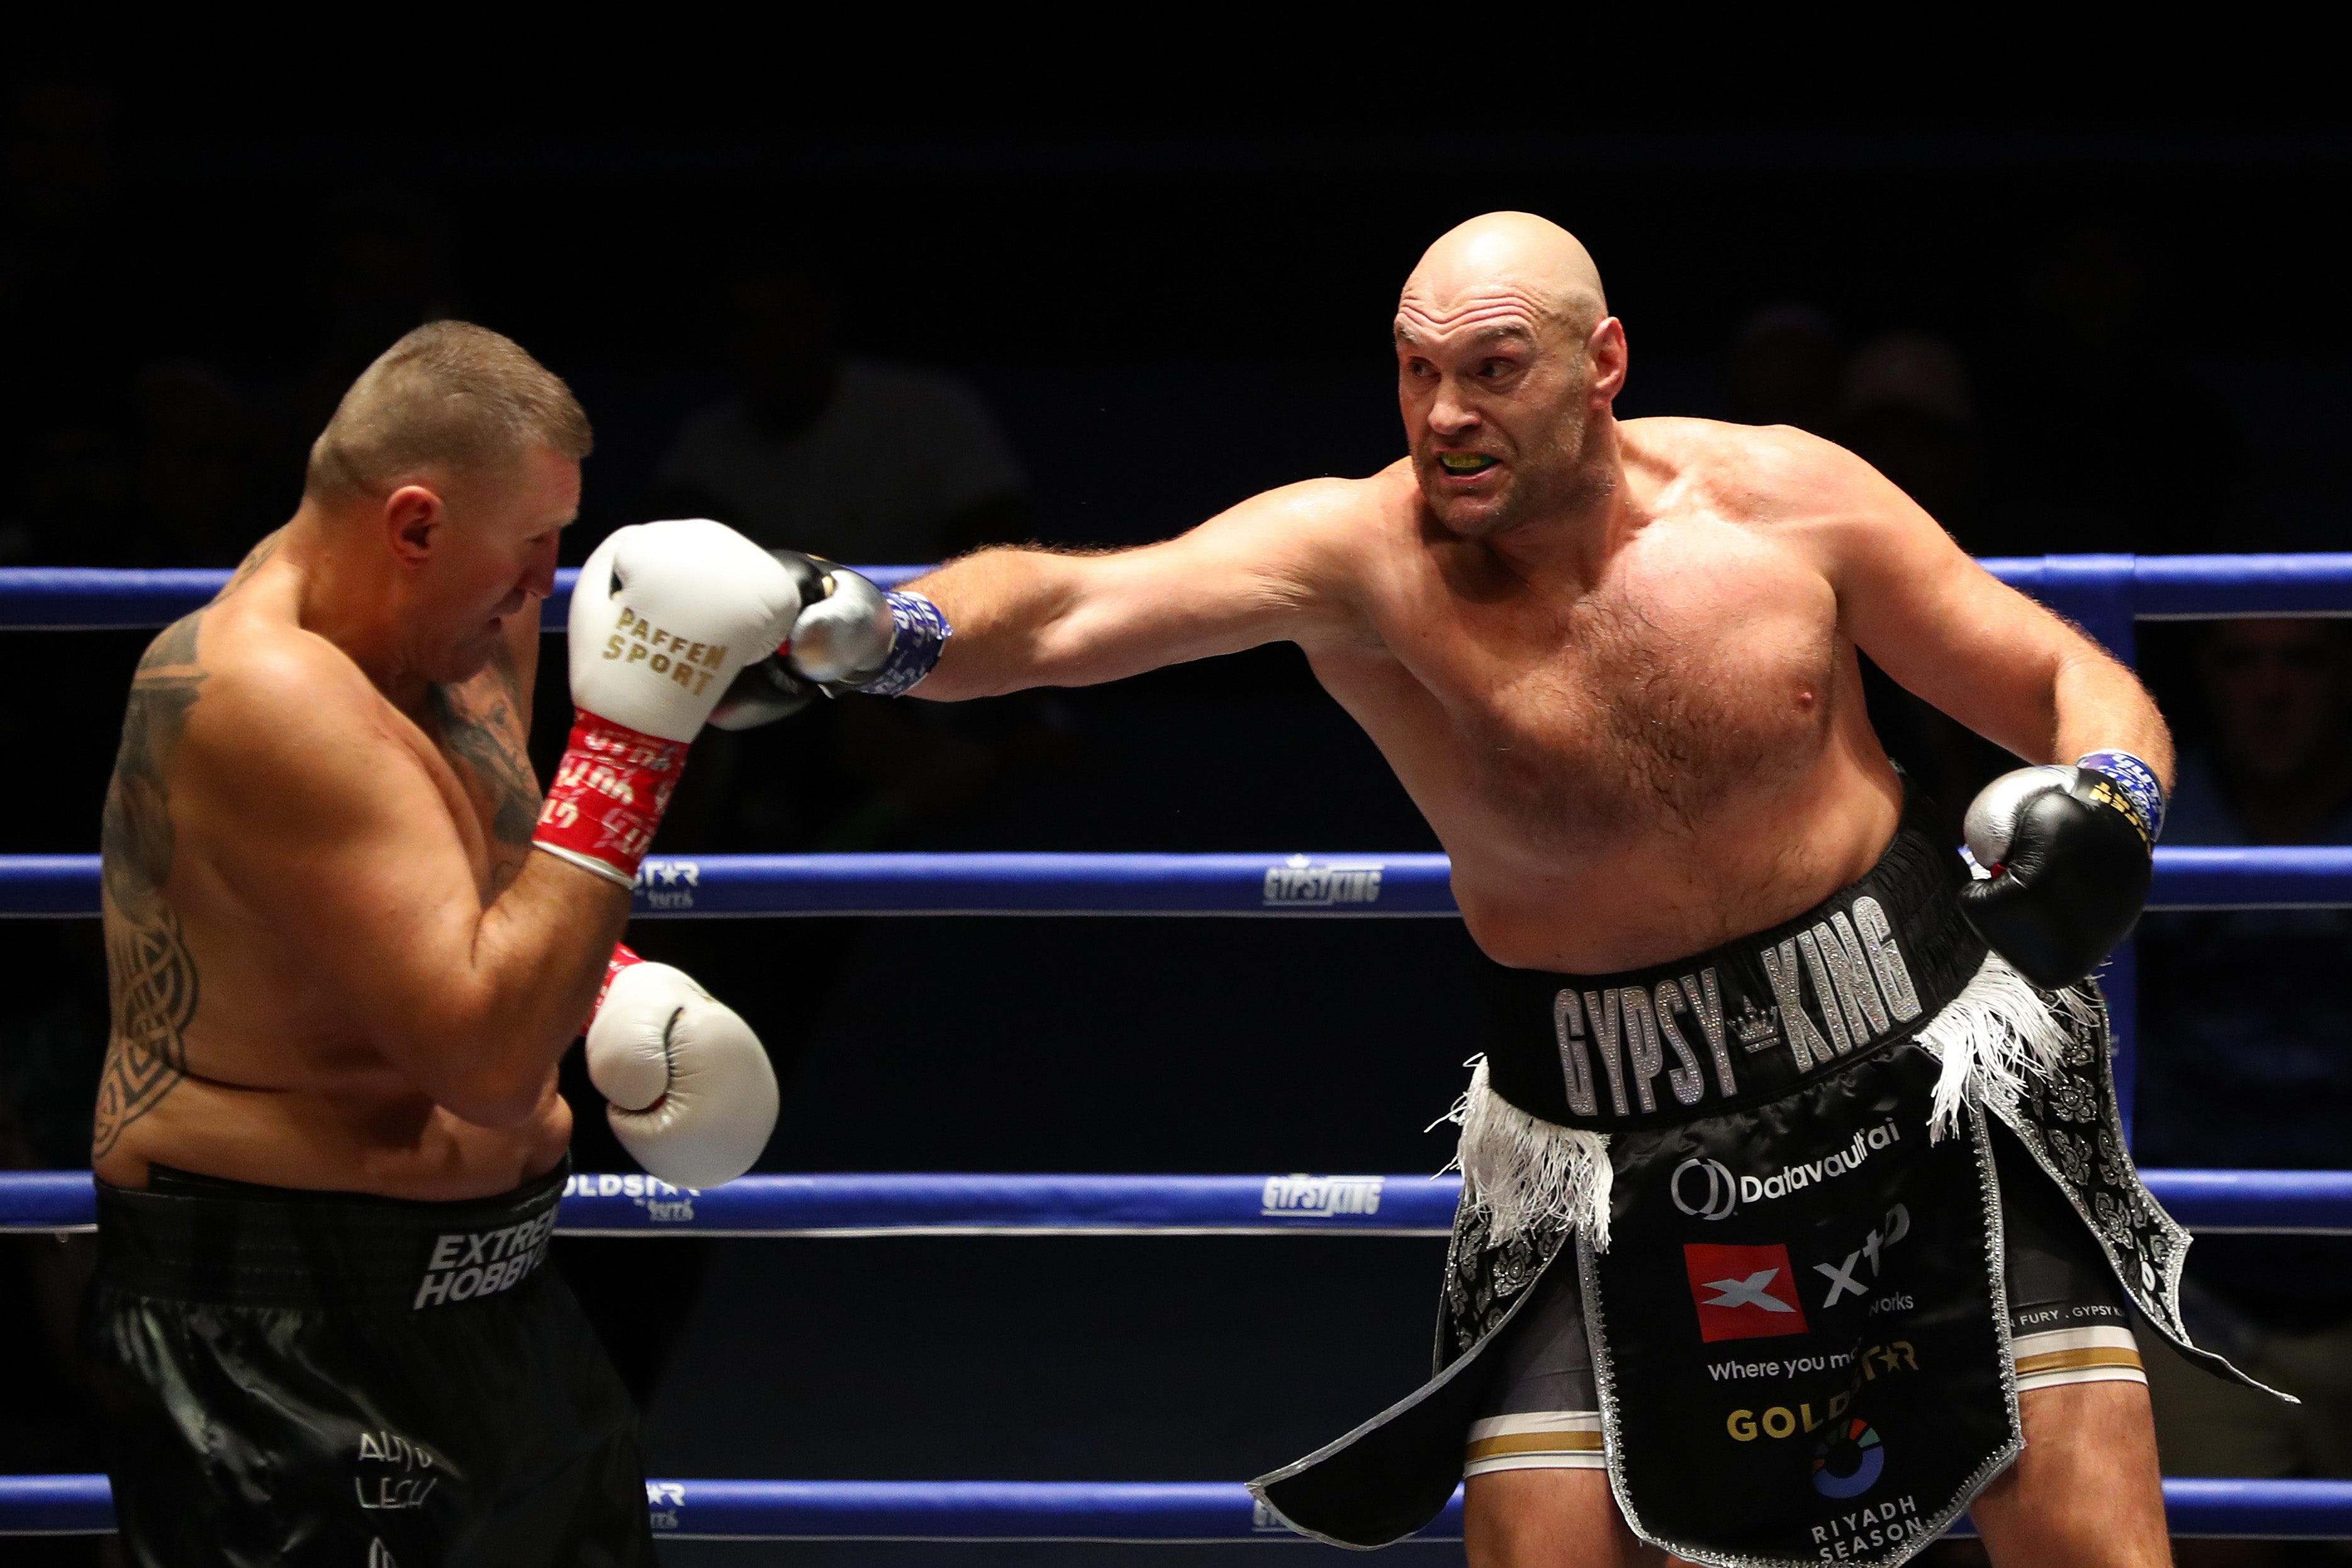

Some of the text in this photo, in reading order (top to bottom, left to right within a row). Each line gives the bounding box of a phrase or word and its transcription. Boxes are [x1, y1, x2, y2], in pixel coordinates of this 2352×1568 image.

[616, 607, 729, 671] PAFFEN
[602, 634, 715, 696] SPORT
[1554, 895, 1923, 1117] GYPSY KING
[2020, 1309, 2059, 1326] FURY
[1707, 1359, 1781, 1382] Where
[1783, 1355, 1825, 1379] you
[1811, 1495, 1917, 1544] RIYADH
[1819, 1516, 1924, 1565] SEASON
